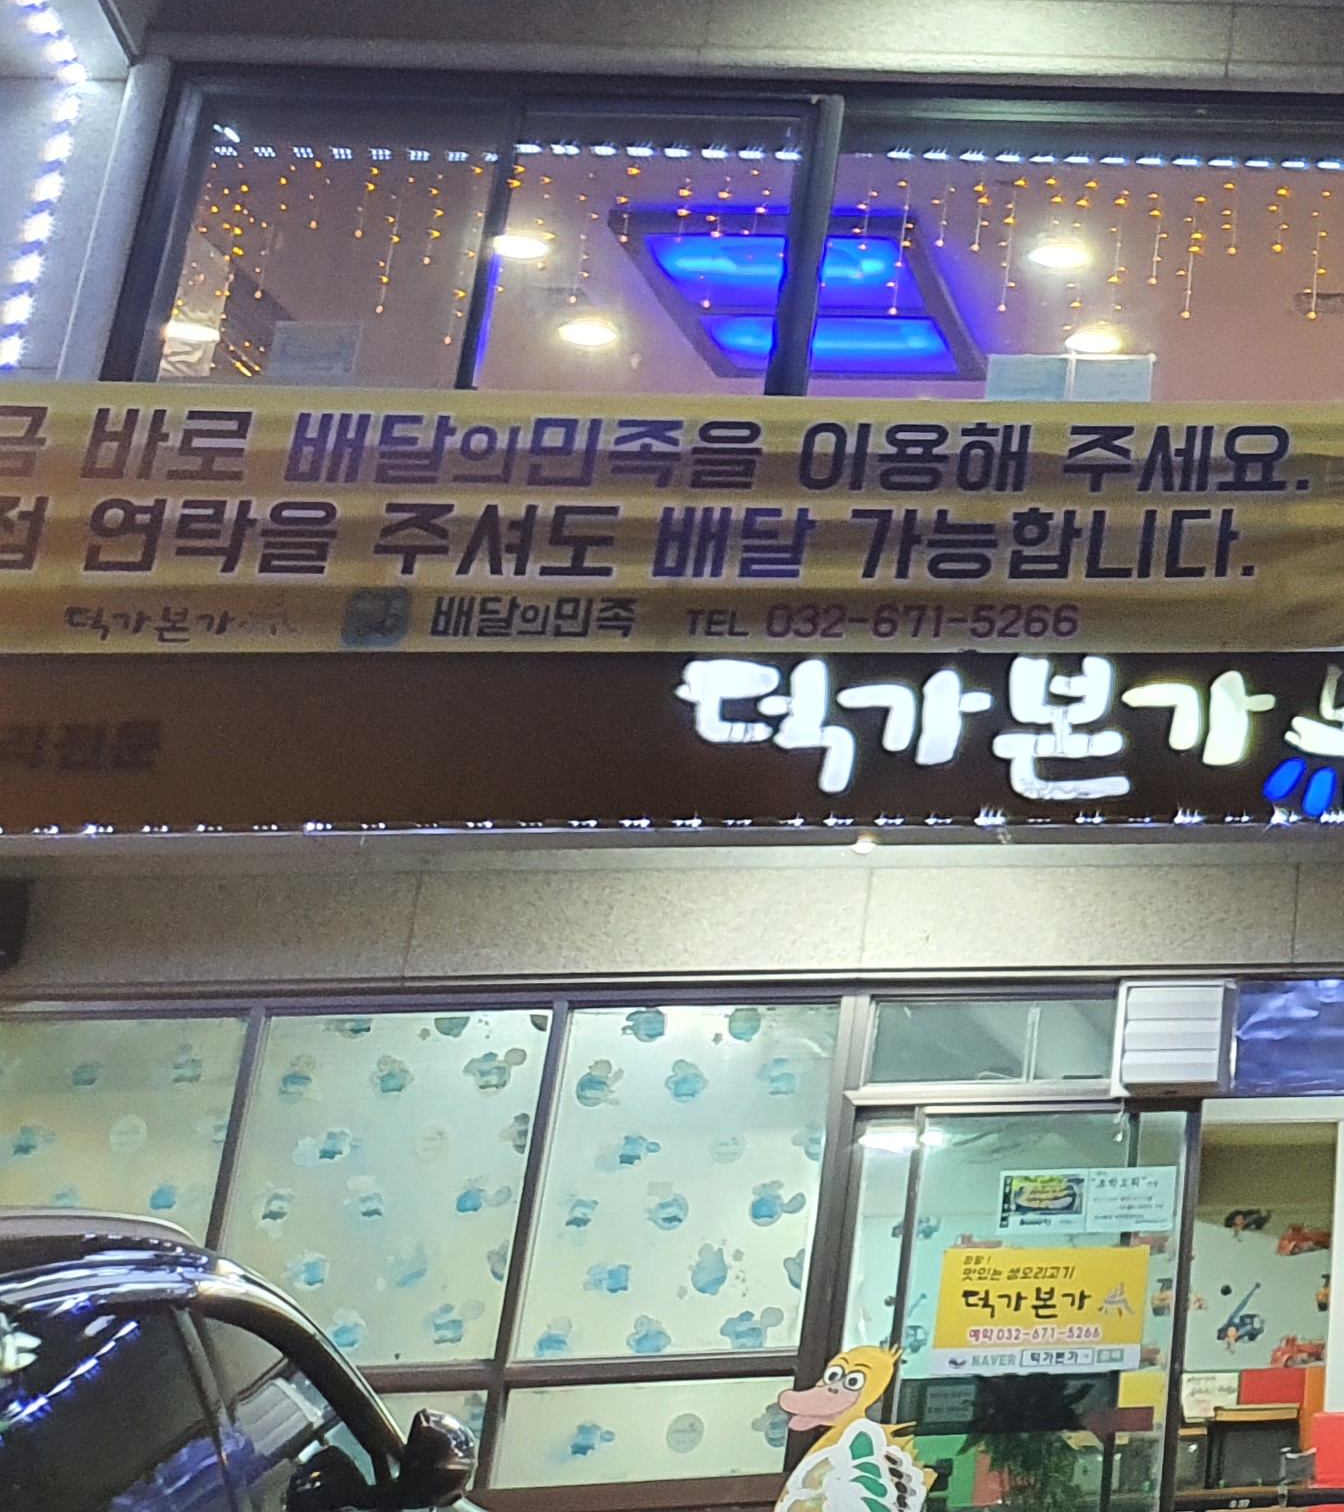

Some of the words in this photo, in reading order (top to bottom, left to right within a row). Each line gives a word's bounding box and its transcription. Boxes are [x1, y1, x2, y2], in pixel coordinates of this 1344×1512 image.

[79, 407, 254, 482] 바로
[282, 413, 763, 490] 배달의민족을
[798, 422, 1033, 493] 이용해
[1062, 424, 1310, 493] 주세요.
[82, 497, 340, 575] 연락을
[373, 502, 621, 578] 주셔도
[651, 505, 817, 581] 배달
[850, 507, 1256, 581] 가능합니다.
[63, 605, 236, 643] 덕가본가
[429, 595, 637, 640] 배달의민족
[686, 607, 750, 637] TEL
[764, 603, 1079, 640] 032-671-5266
[675, 654, 1277, 800] 덕가본가
[962, 1267, 1003, 1282] 맛있는
[961, 1286, 1093, 1319] 덕가본가
[971, 1354, 1017, 1367] NAVER
